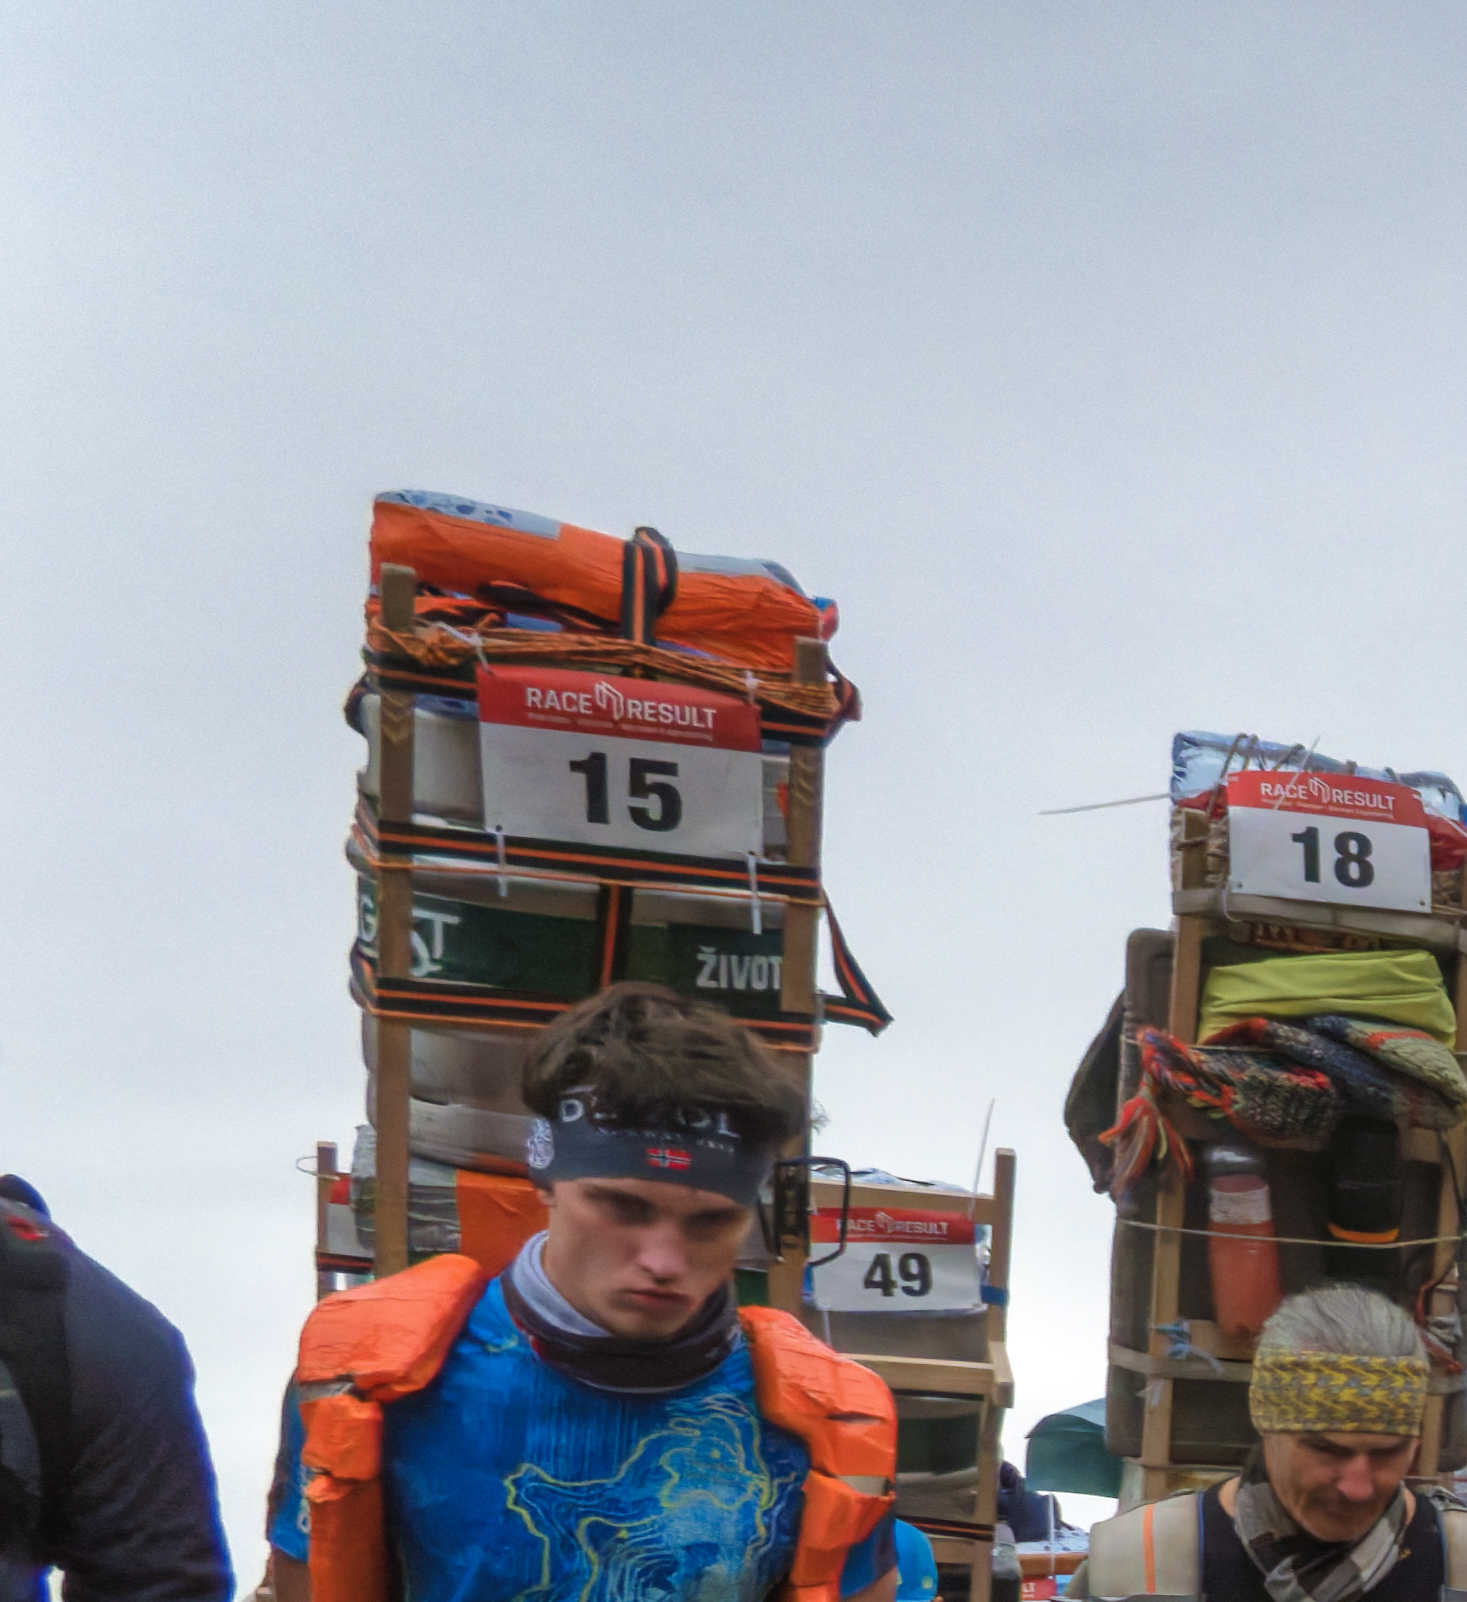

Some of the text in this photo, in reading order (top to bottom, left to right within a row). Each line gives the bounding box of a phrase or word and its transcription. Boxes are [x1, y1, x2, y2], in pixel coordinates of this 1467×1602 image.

[526, 687, 593, 714] RACE
[627, 699, 717, 729] RESULT
[569, 752, 682, 832] 15
[1260, 783, 1308, 800] RACE
[1332, 789, 1395, 811] RESULT
[1291, 826, 1374, 888] 18
[896, 1220, 949, 1236] RESULT
[863, 1252, 933, 1298] 49
